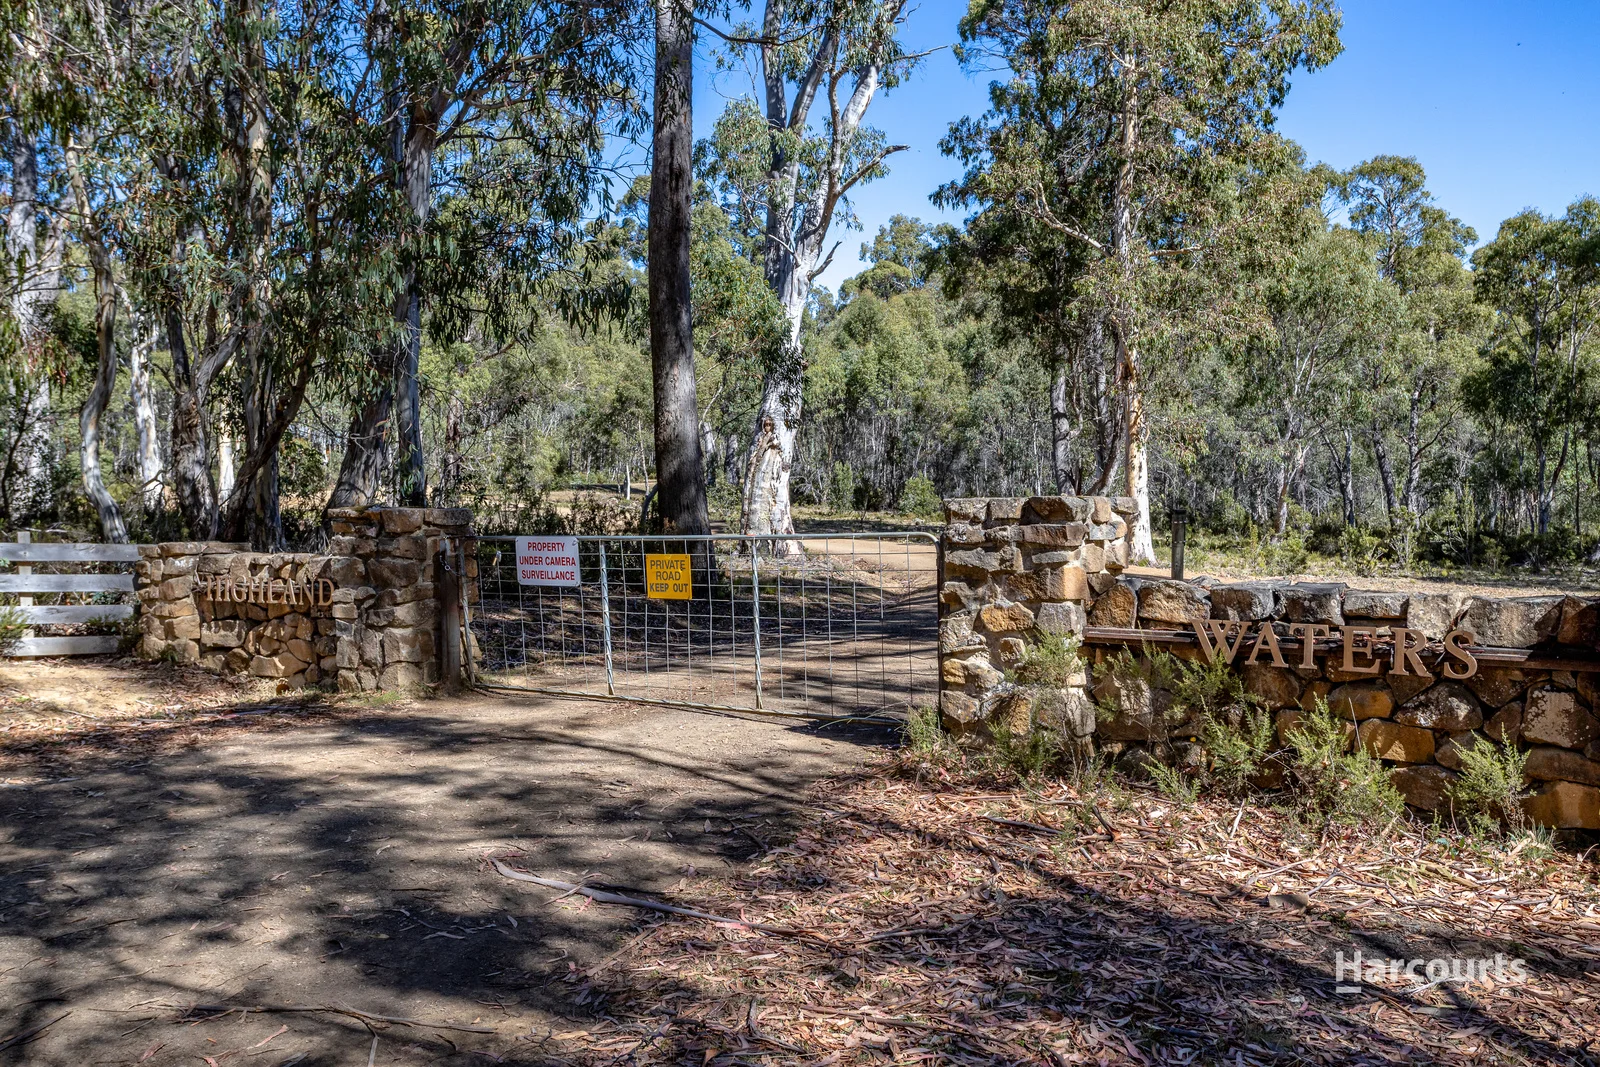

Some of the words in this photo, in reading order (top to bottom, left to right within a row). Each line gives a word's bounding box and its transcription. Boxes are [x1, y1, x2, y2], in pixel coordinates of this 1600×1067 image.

[527, 542, 565, 552] PROPERTY
[519, 556, 543, 566] UNDER
[545, 556, 576, 566] CAMERA
[650, 560, 685, 571] PRIVATE
[521, 570, 575, 580] SURVEILLANCE
[656, 571, 681, 581] ROAD
[206, 575, 335, 606] HIGHLAND
[650, 583, 669, 592] KEEP
[673, 583, 688, 593] OUT
[1191, 619, 1478, 679] WATERS
